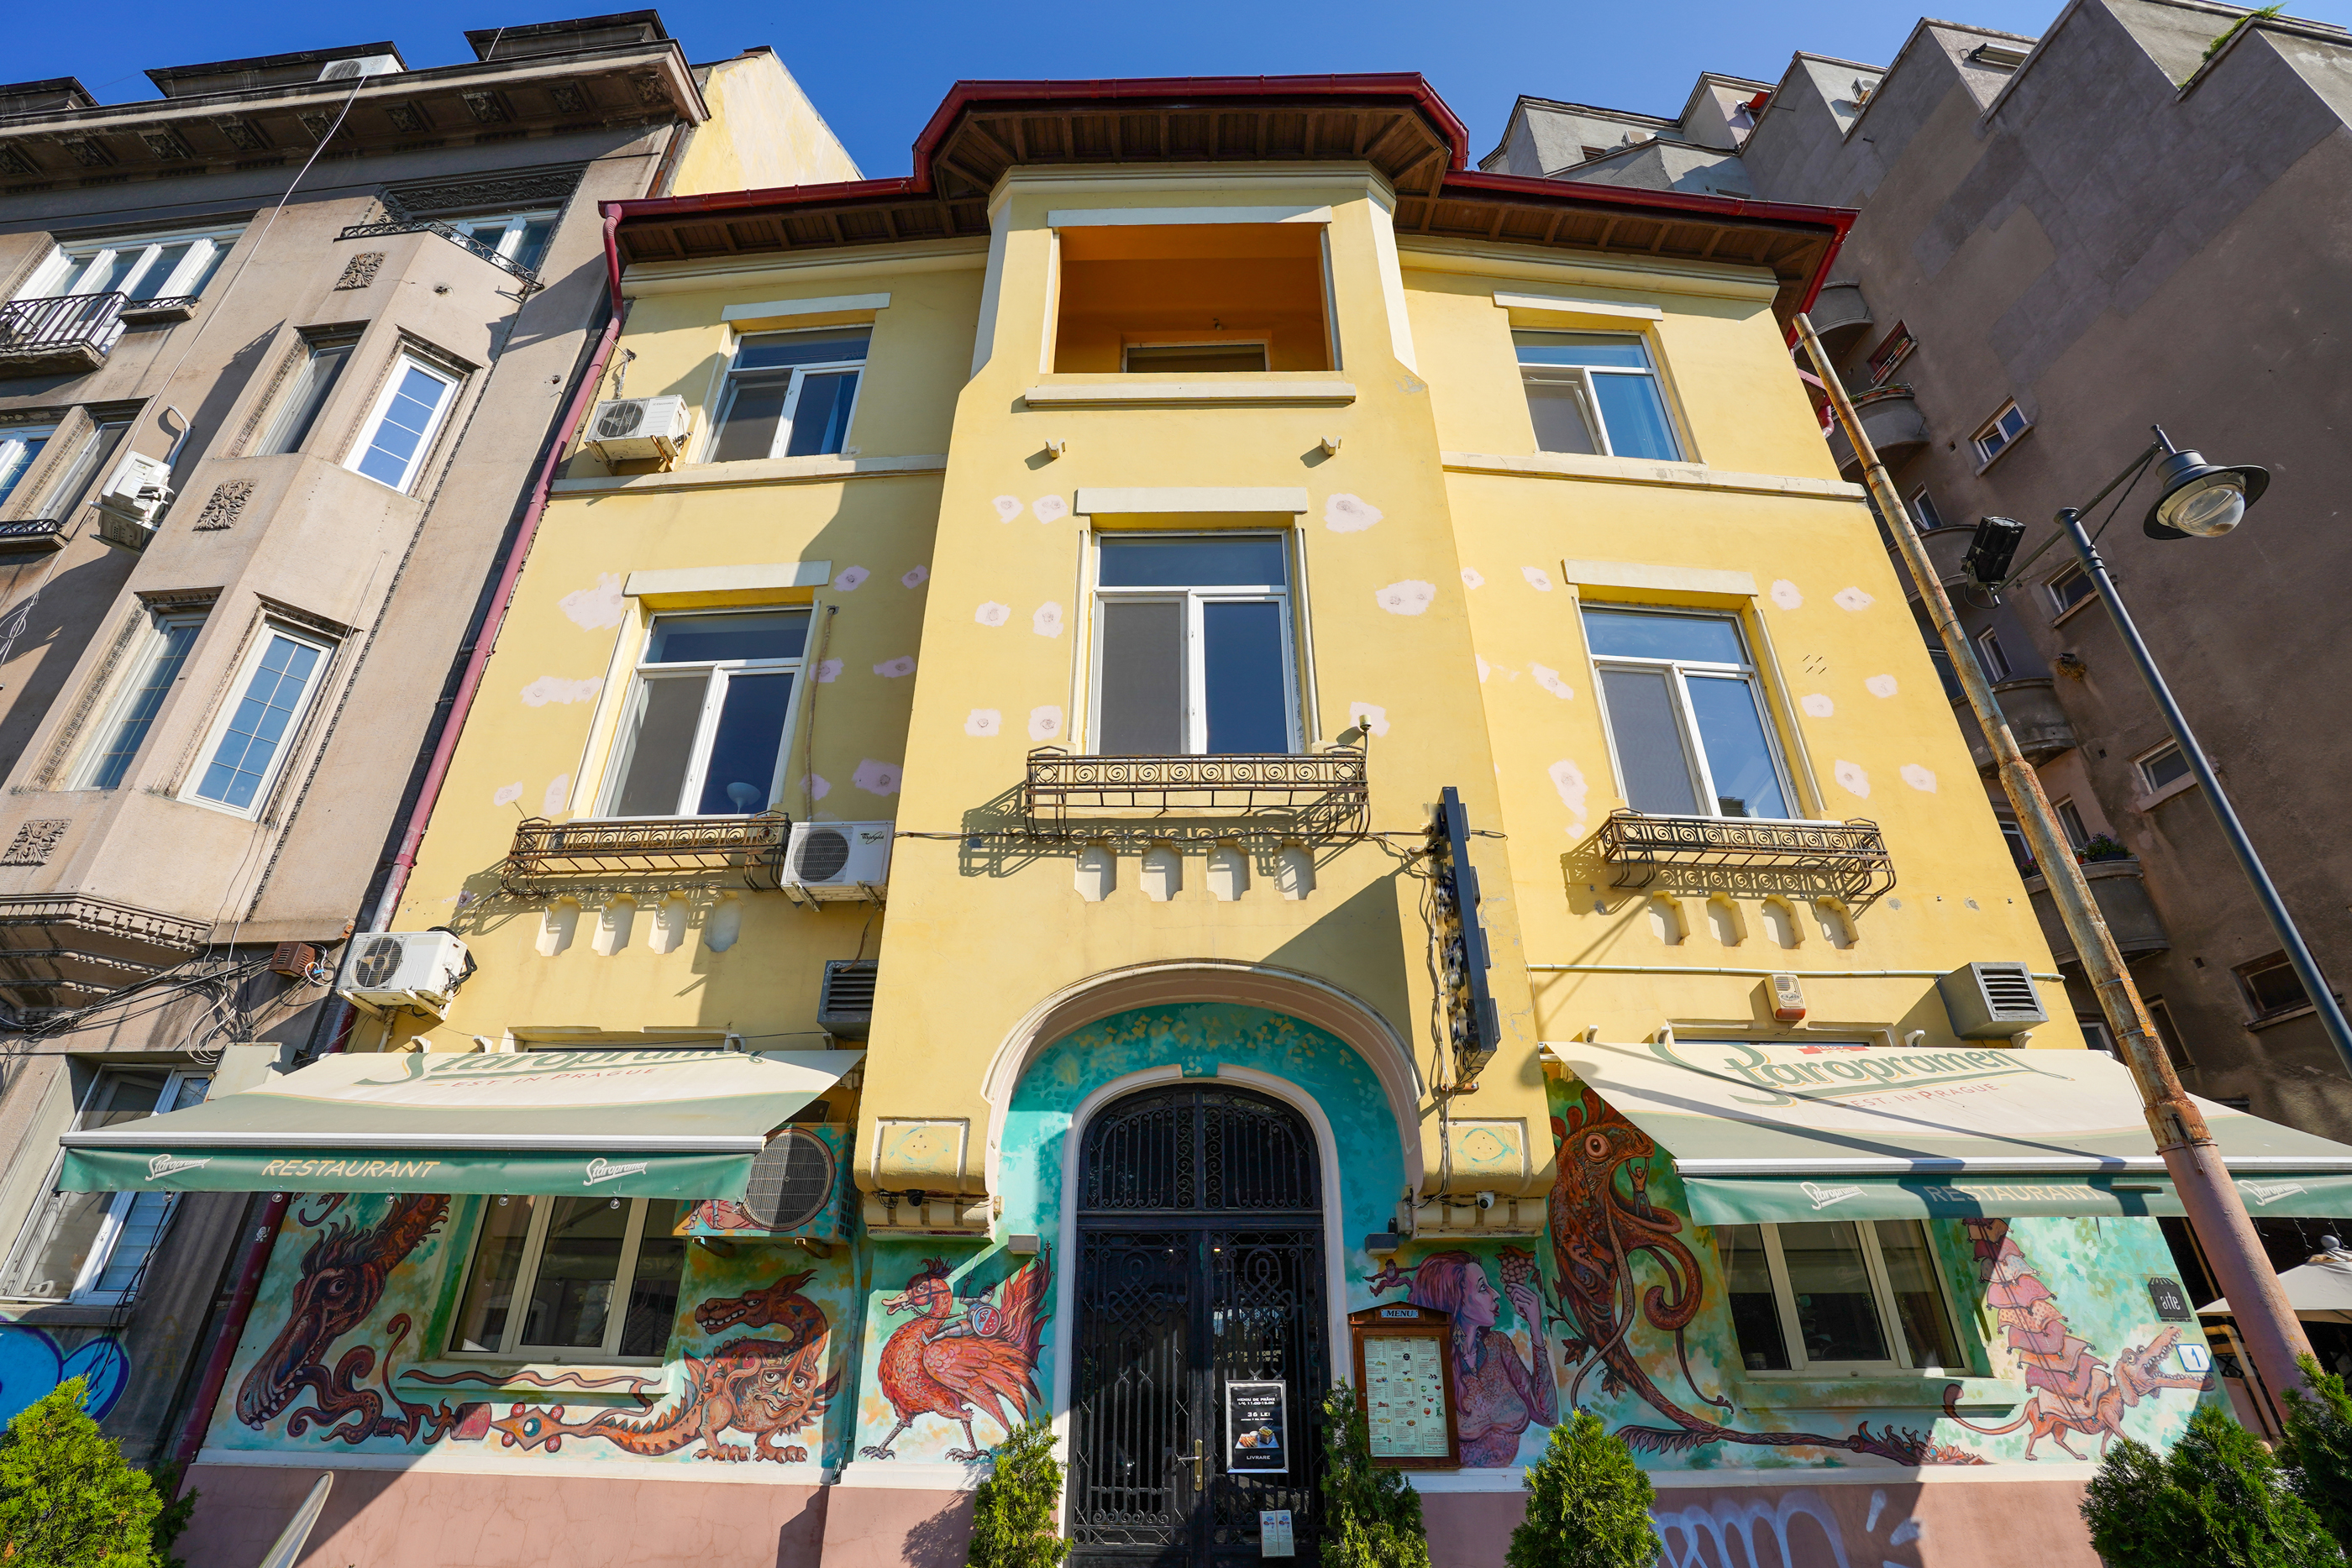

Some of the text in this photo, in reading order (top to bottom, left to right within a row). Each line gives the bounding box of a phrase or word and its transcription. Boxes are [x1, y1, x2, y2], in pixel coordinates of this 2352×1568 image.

[512, 1076, 542, 1084] IN
[550, 1067, 659, 1081] PRAGUE
[1648, 1043, 2071, 1108] Staropramen
[1893, 1094, 1919, 1103] IN
[1917, 1083, 1999, 1099] PRAGUE
[144, 1153, 213, 1182] Staropramen
[261, 1159, 441, 1178] RESTAURANT
[583, 1157, 651, 1187] Staropramen
[1799, 1181, 1868, 1211] Staropramen
[1923, 1185, 2103, 1202] RESTAURANT
[2237, 1179, 2308, 1207] Staropramen
[2160, 1292, 2181, 1310] arte
[2191, 1347, 2202, 1368] 1
